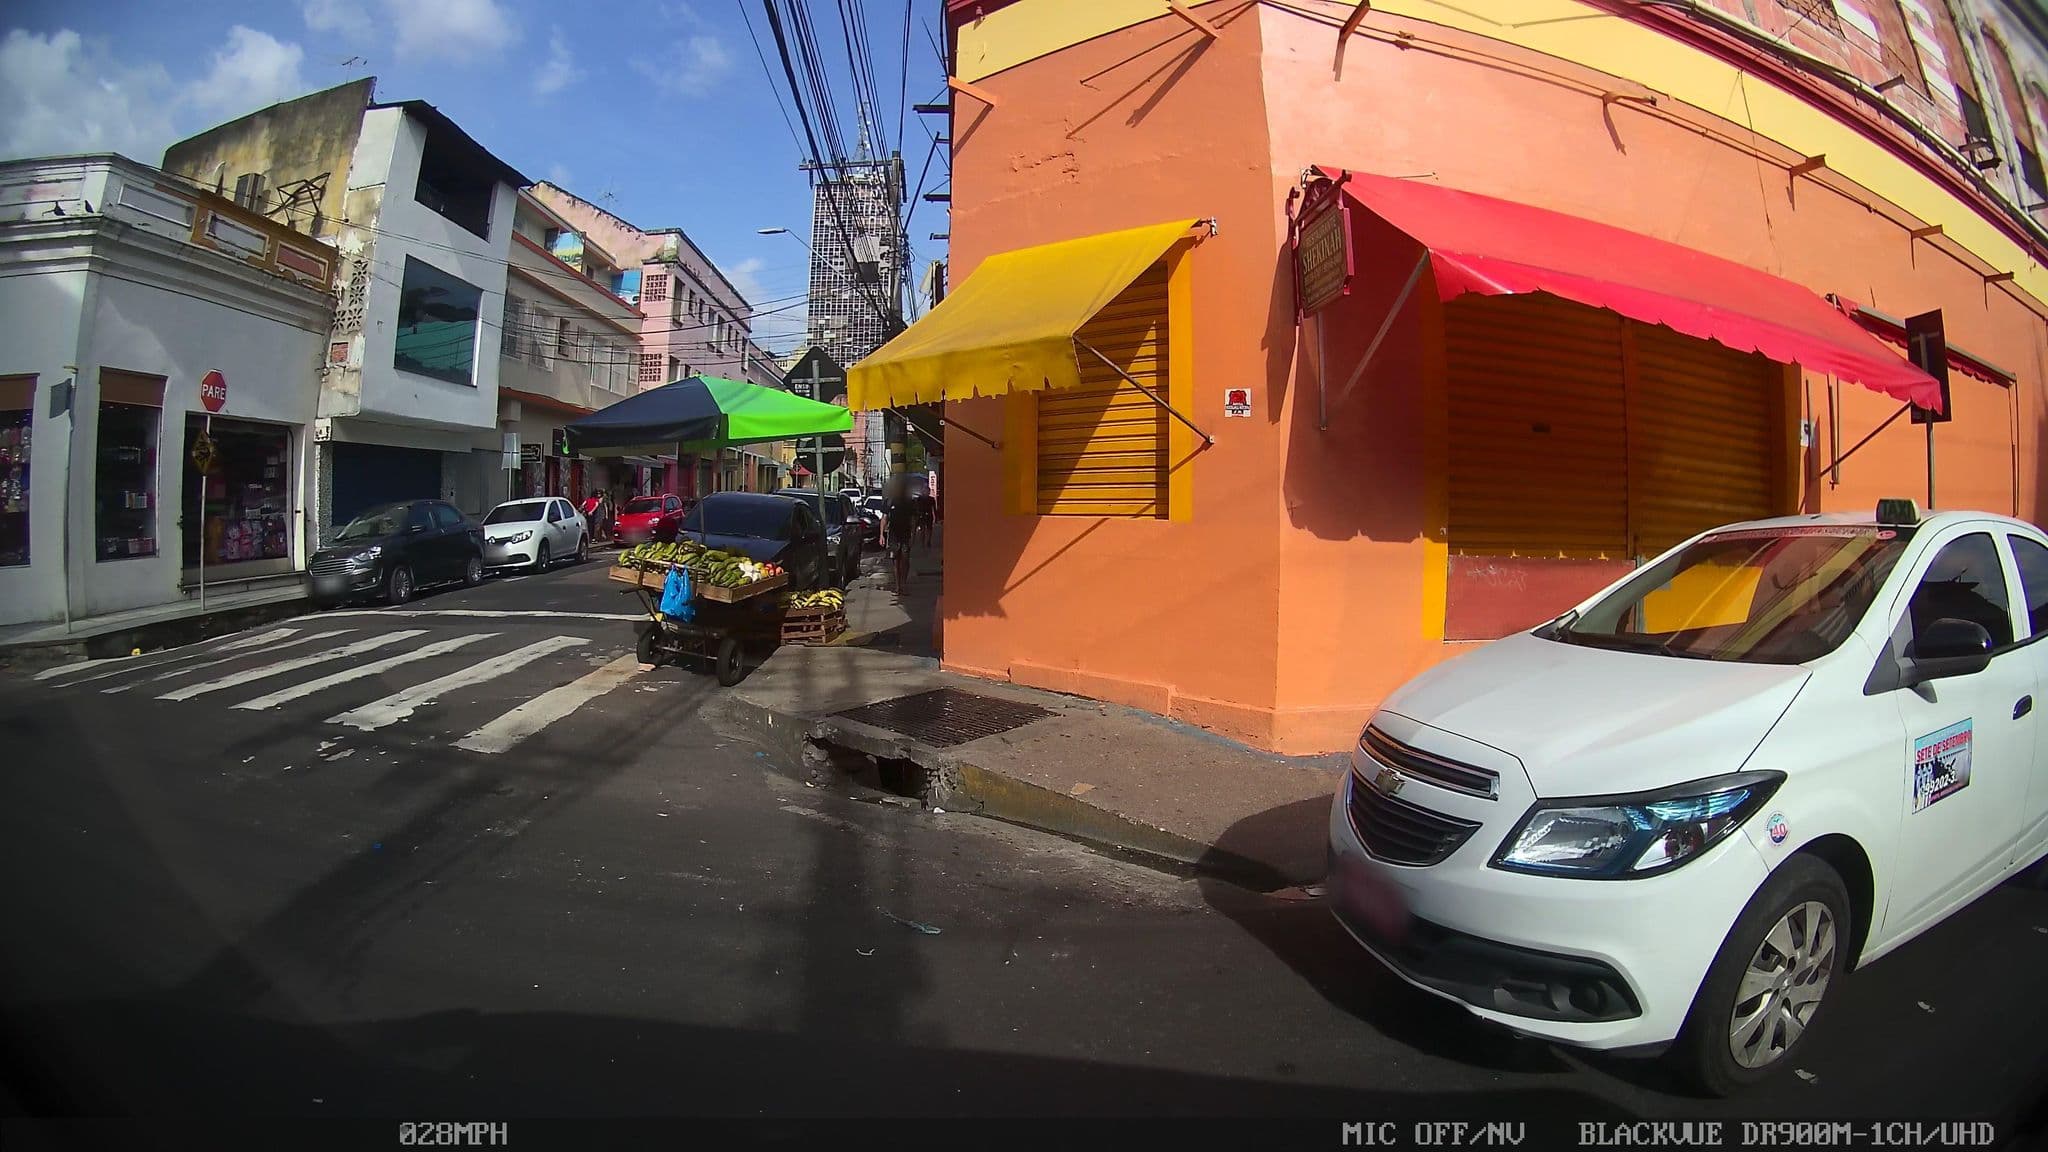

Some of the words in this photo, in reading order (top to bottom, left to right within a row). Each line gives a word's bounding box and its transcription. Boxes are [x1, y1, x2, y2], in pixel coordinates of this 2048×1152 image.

[1302, 227, 1342, 275] SHEKINAH
[202, 384, 226, 401] PARE
[1916, 744, 1932, 763] SETE
[1933, 741, 1941, 756] DE
